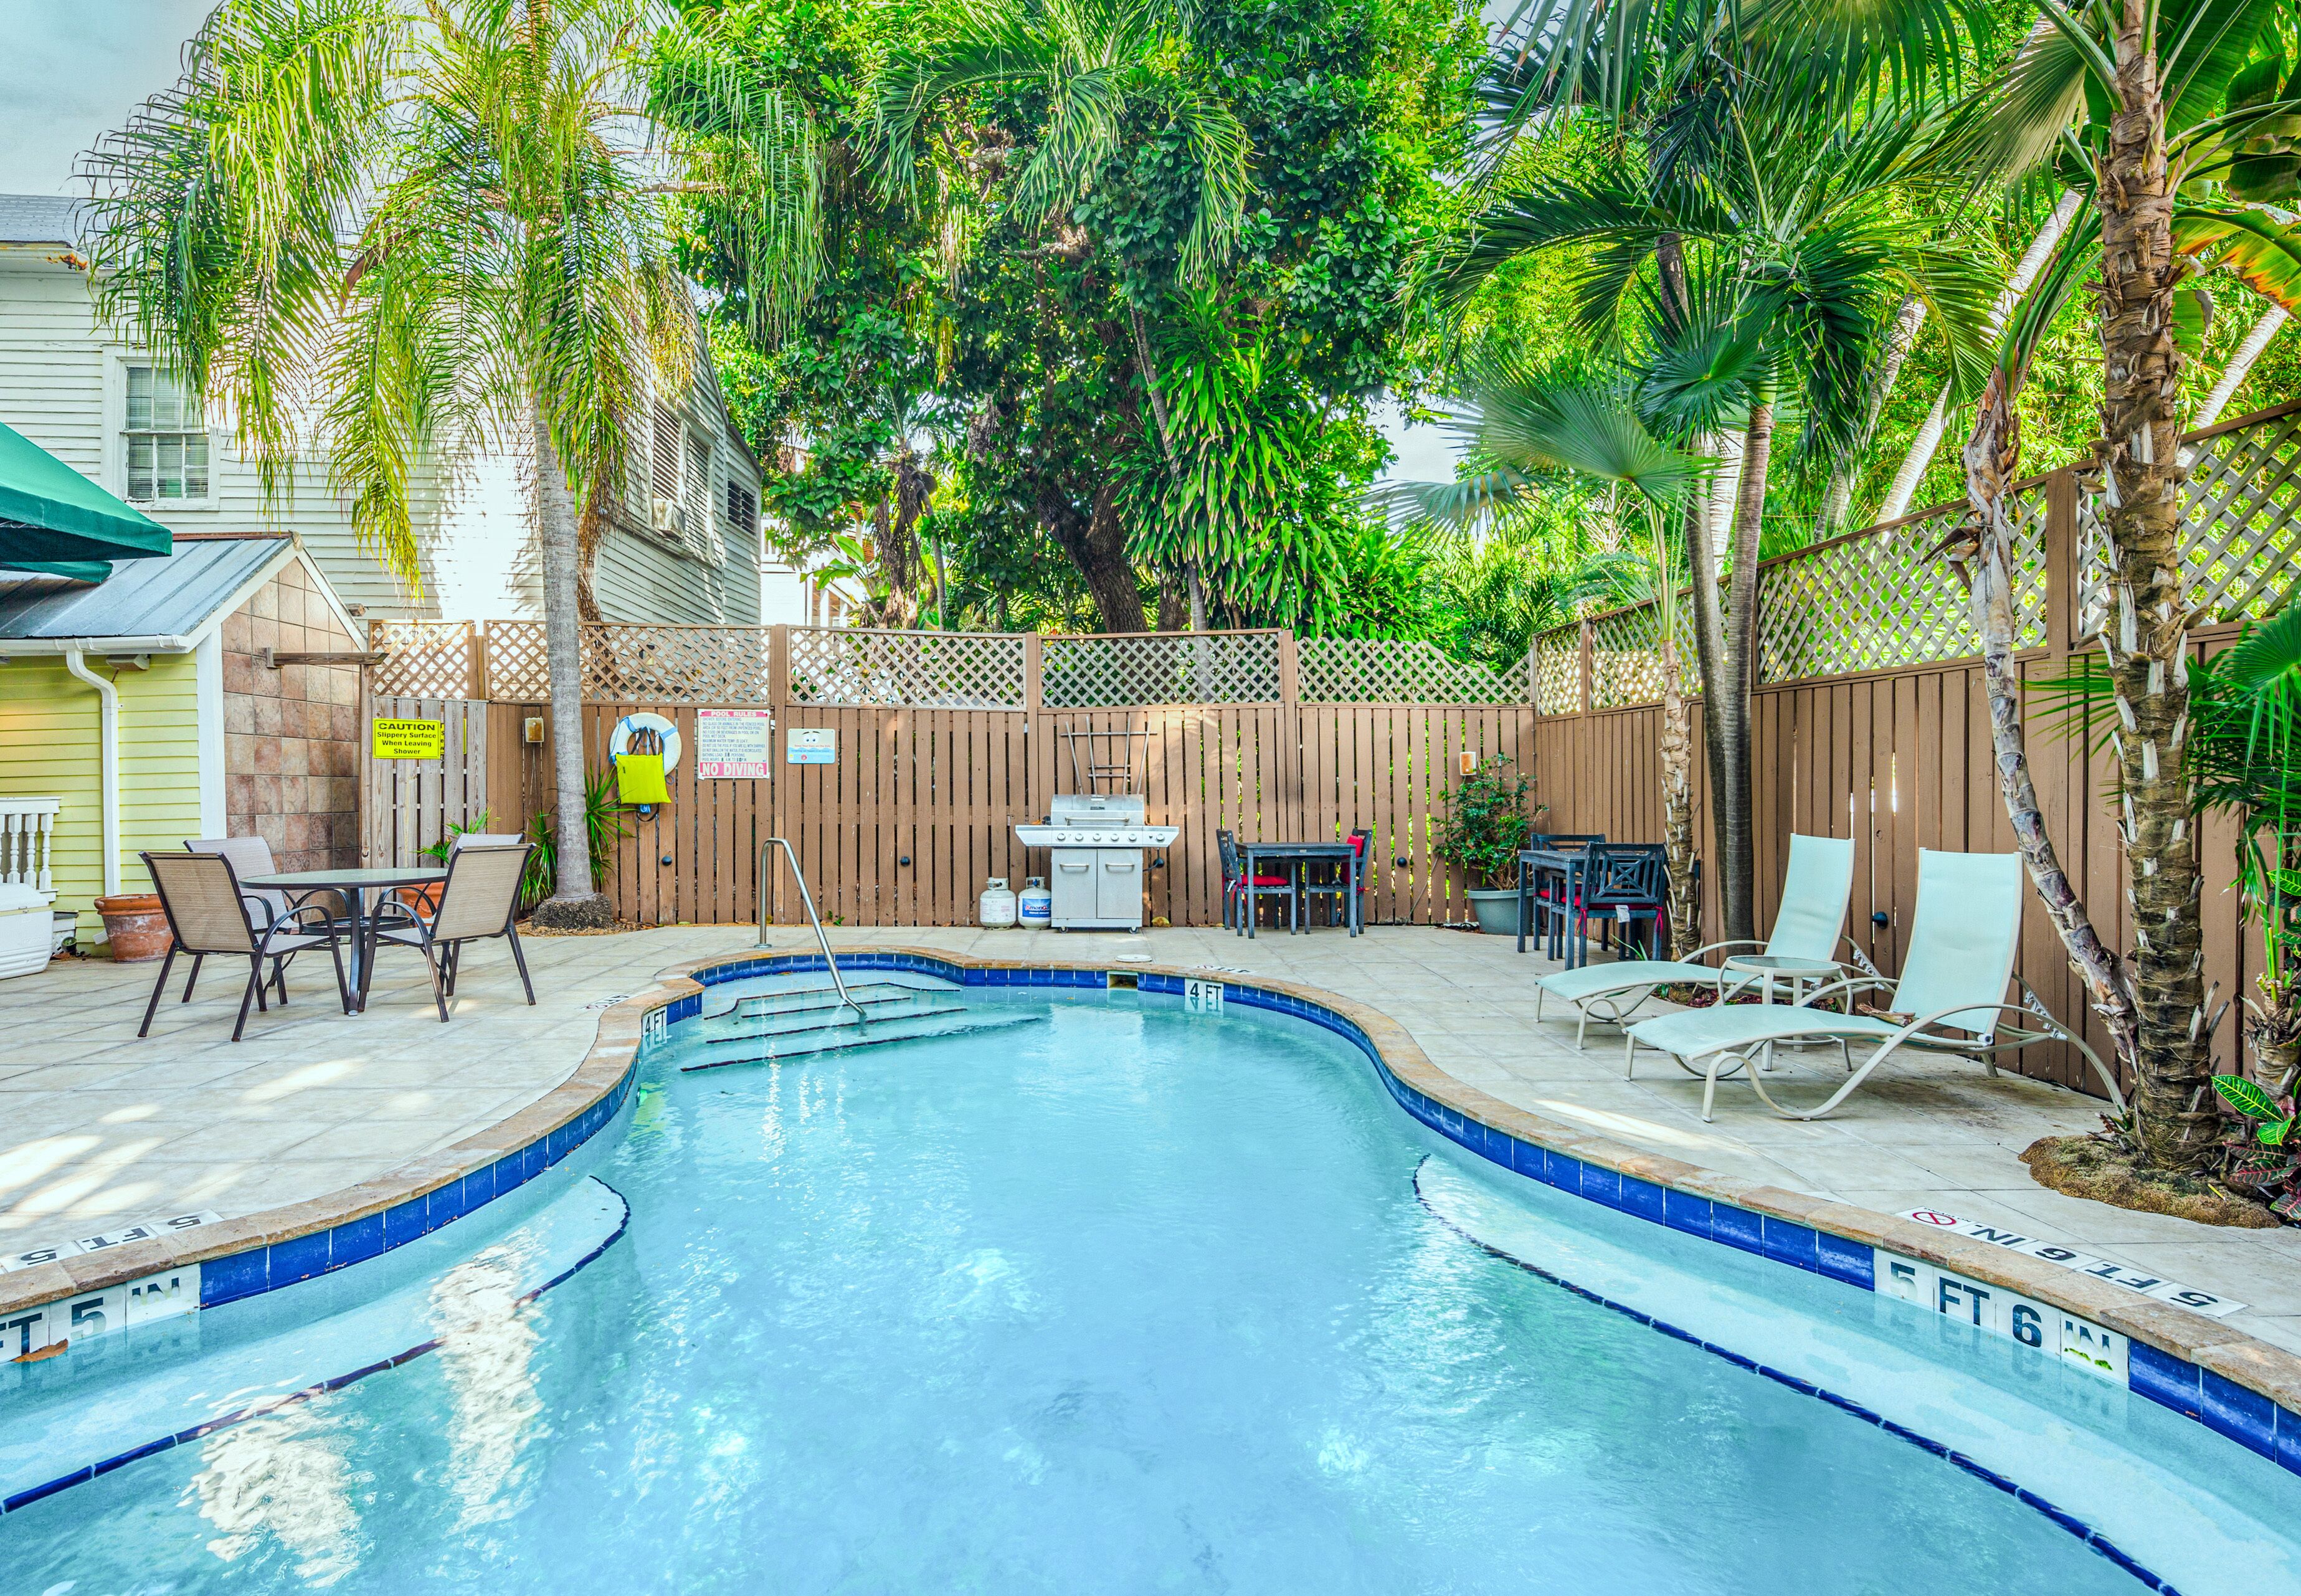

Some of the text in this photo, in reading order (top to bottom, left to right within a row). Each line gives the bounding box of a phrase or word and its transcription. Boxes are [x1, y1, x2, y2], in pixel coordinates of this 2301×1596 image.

[703, 763, 764, 776] NO DIVING
[1190, 983, 1221, 1000] 4 FT
[645, 1009, 665, 1033] 4 FT
[167, 1216, 201, 1229] 5
[20, 1249, 57, 1265] 5
[2035, 1248, 2077, 1261] 6
[1891, 1261, 1918, 1298] 5
[1939, 1276, 1990, 1326] FT
[2012, 1304, 2042, 1348] 6
[2169, 1292, 2218, 1308] 5
[0, 1313, 42, 1356] T
[71, 1297, 107, 1339] 5
